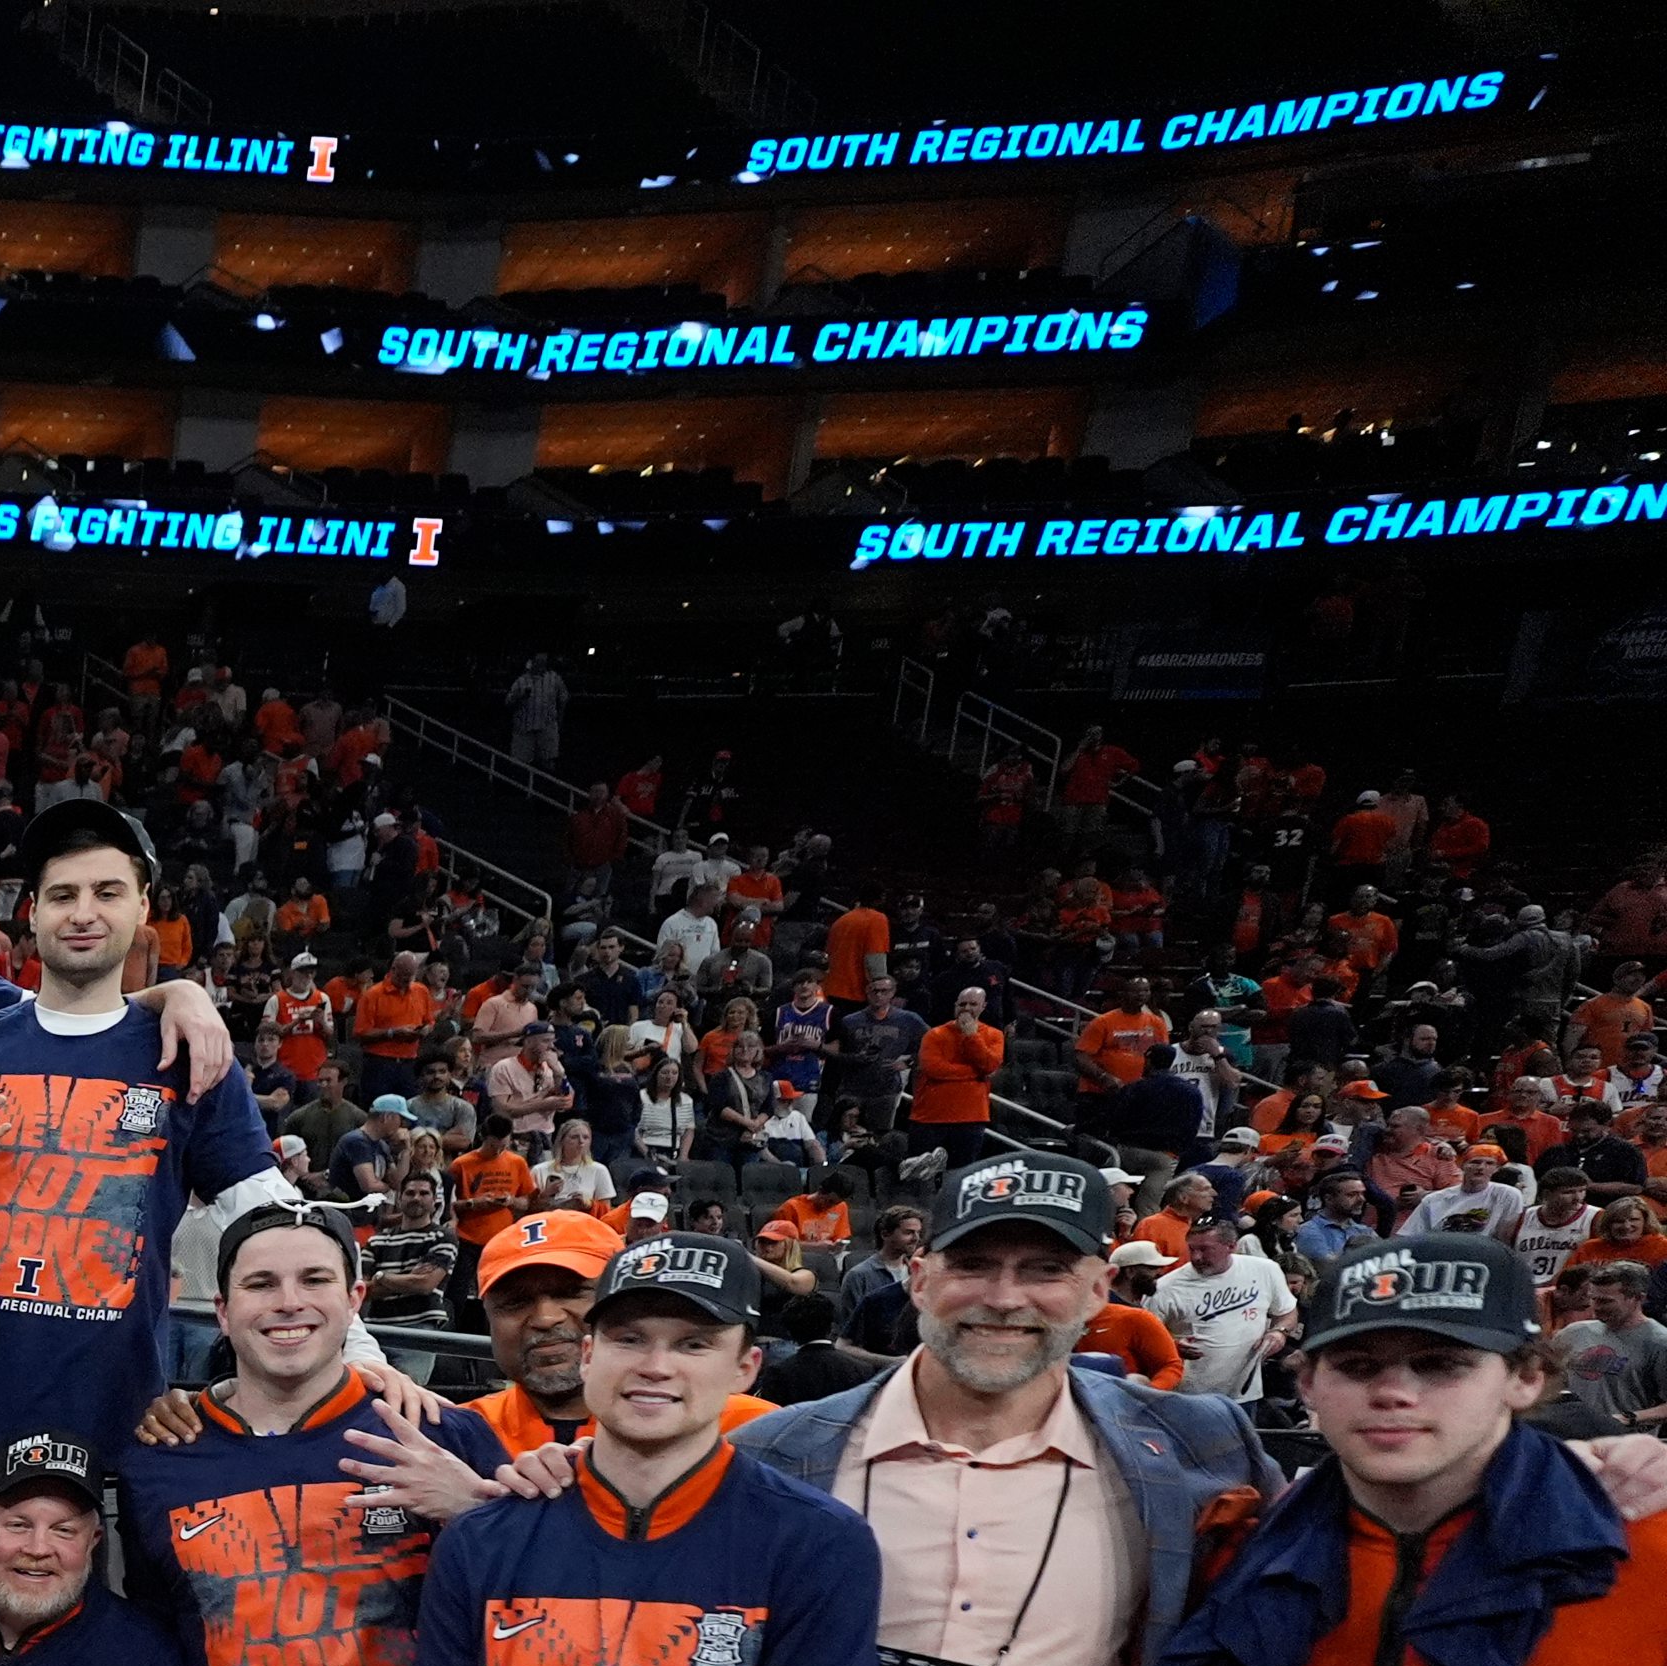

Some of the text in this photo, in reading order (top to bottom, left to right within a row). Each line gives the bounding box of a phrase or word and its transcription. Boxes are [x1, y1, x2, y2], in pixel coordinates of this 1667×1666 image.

[745, 70, 1505, 175] SOUTH REGIONAL CHAMPIONS
[163, 133, 294, 175] ILLINI
[378, 310, 1148, 373] SOUTH REGIONAL CHAMPIONS
[29, 504, 244, 552] FIGHTING
[256, 515, 395, 558] ILLINI
[855, 483, 1667, 563] SOUTH REGIONAL CHAMPION
[1273, 828, 1304, 848] 32
[962, 1158, 1029, 1191] FINAL
[618, 1237, 674, 1261] FINAL
[1340, 1248, 1415, 1283] FINAL
[1533, 1256, 1555, 1275] 31
[0, 1298, 72, 1316] REGIONAL
[1195, 1282, 1260, 1318] Illini
[1241, 1308, 1258, 1321] 15
[8, 1434, 52, 1454] FINAL
[369, 1514, 402, 1528] FOUR
